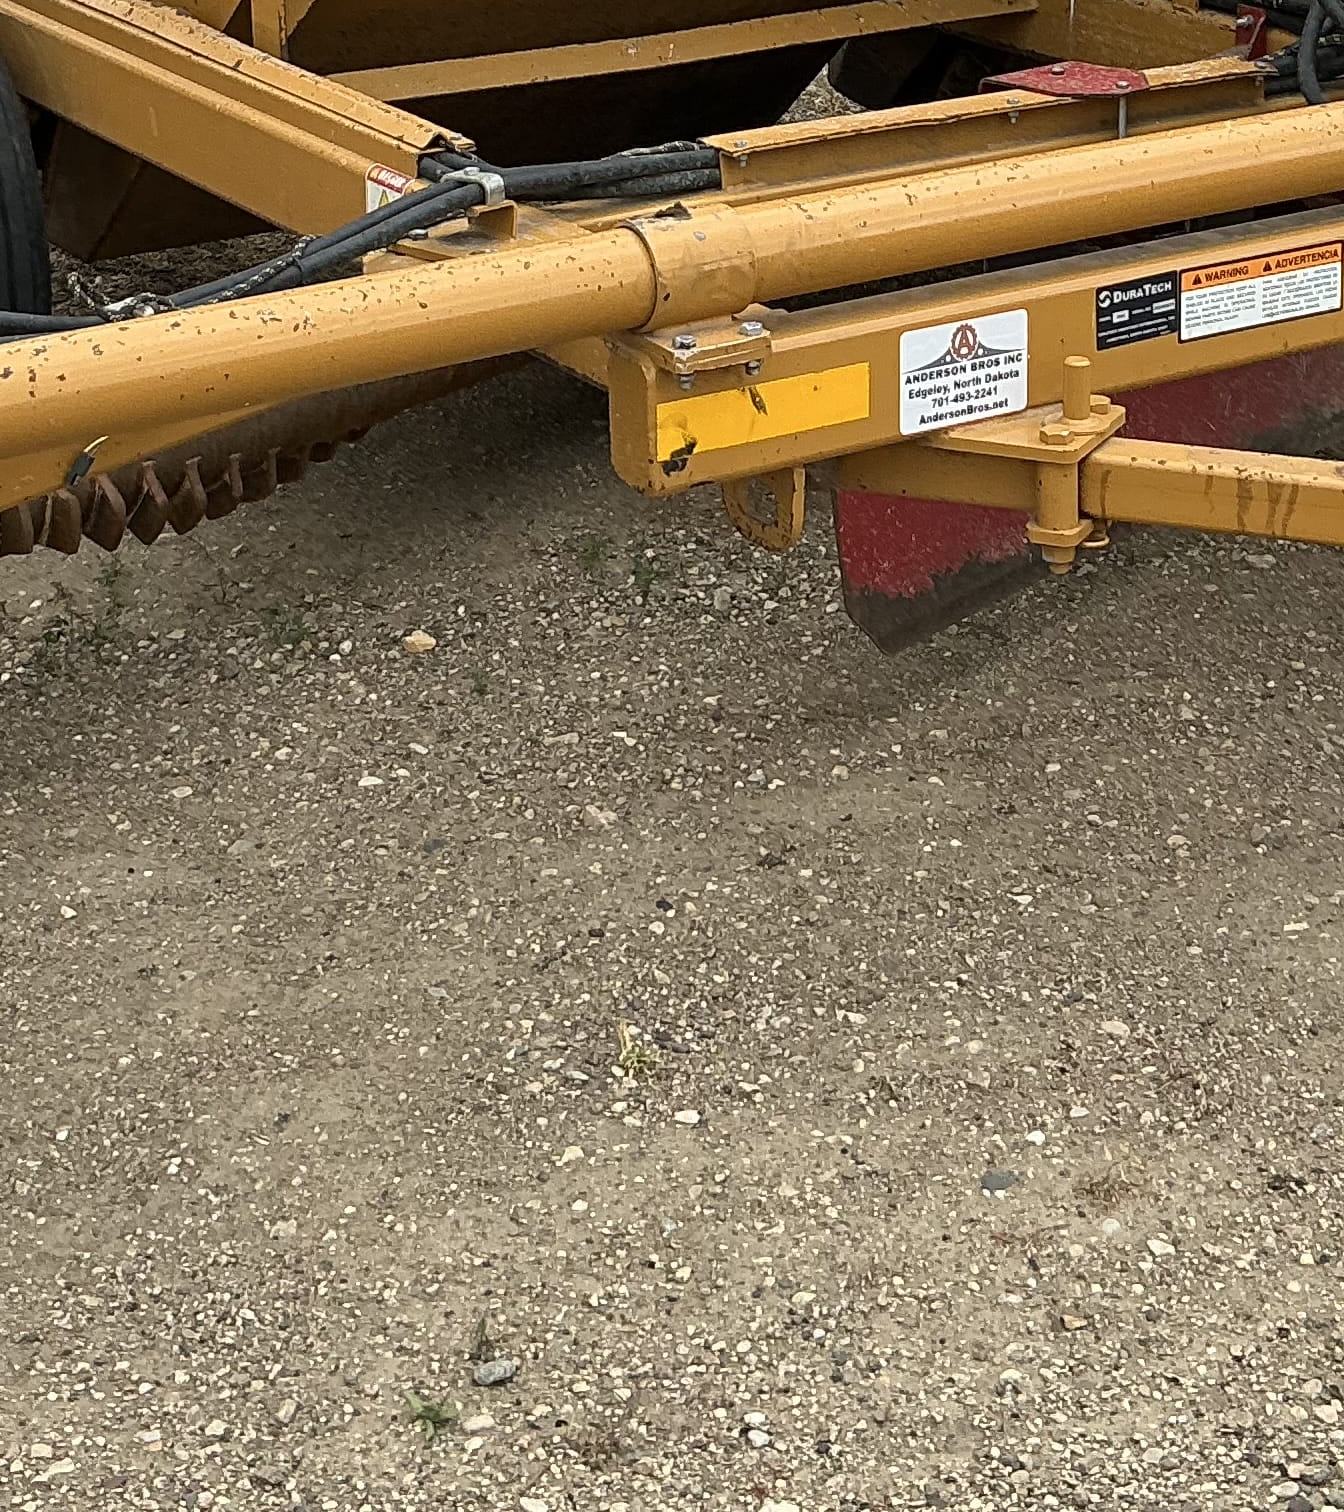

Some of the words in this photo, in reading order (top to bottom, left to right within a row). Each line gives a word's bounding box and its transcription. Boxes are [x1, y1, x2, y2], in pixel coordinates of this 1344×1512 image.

[1204, 265, 1249, 282] WARNING
[1274, 248, 1339, 270] ADVERTENCIA
[904, 364, 967, 386] ANDERSON
[970, 357, 1001, 372] BROS
[1003, 353, 1023, 365] INC
[953, 377, 982, 391] North
[984, 369, 1020, 385] Dakota
[931, 386, 998, 409] 701-493-2241
[918, 398, 1009, 426] AndersonBros.net
